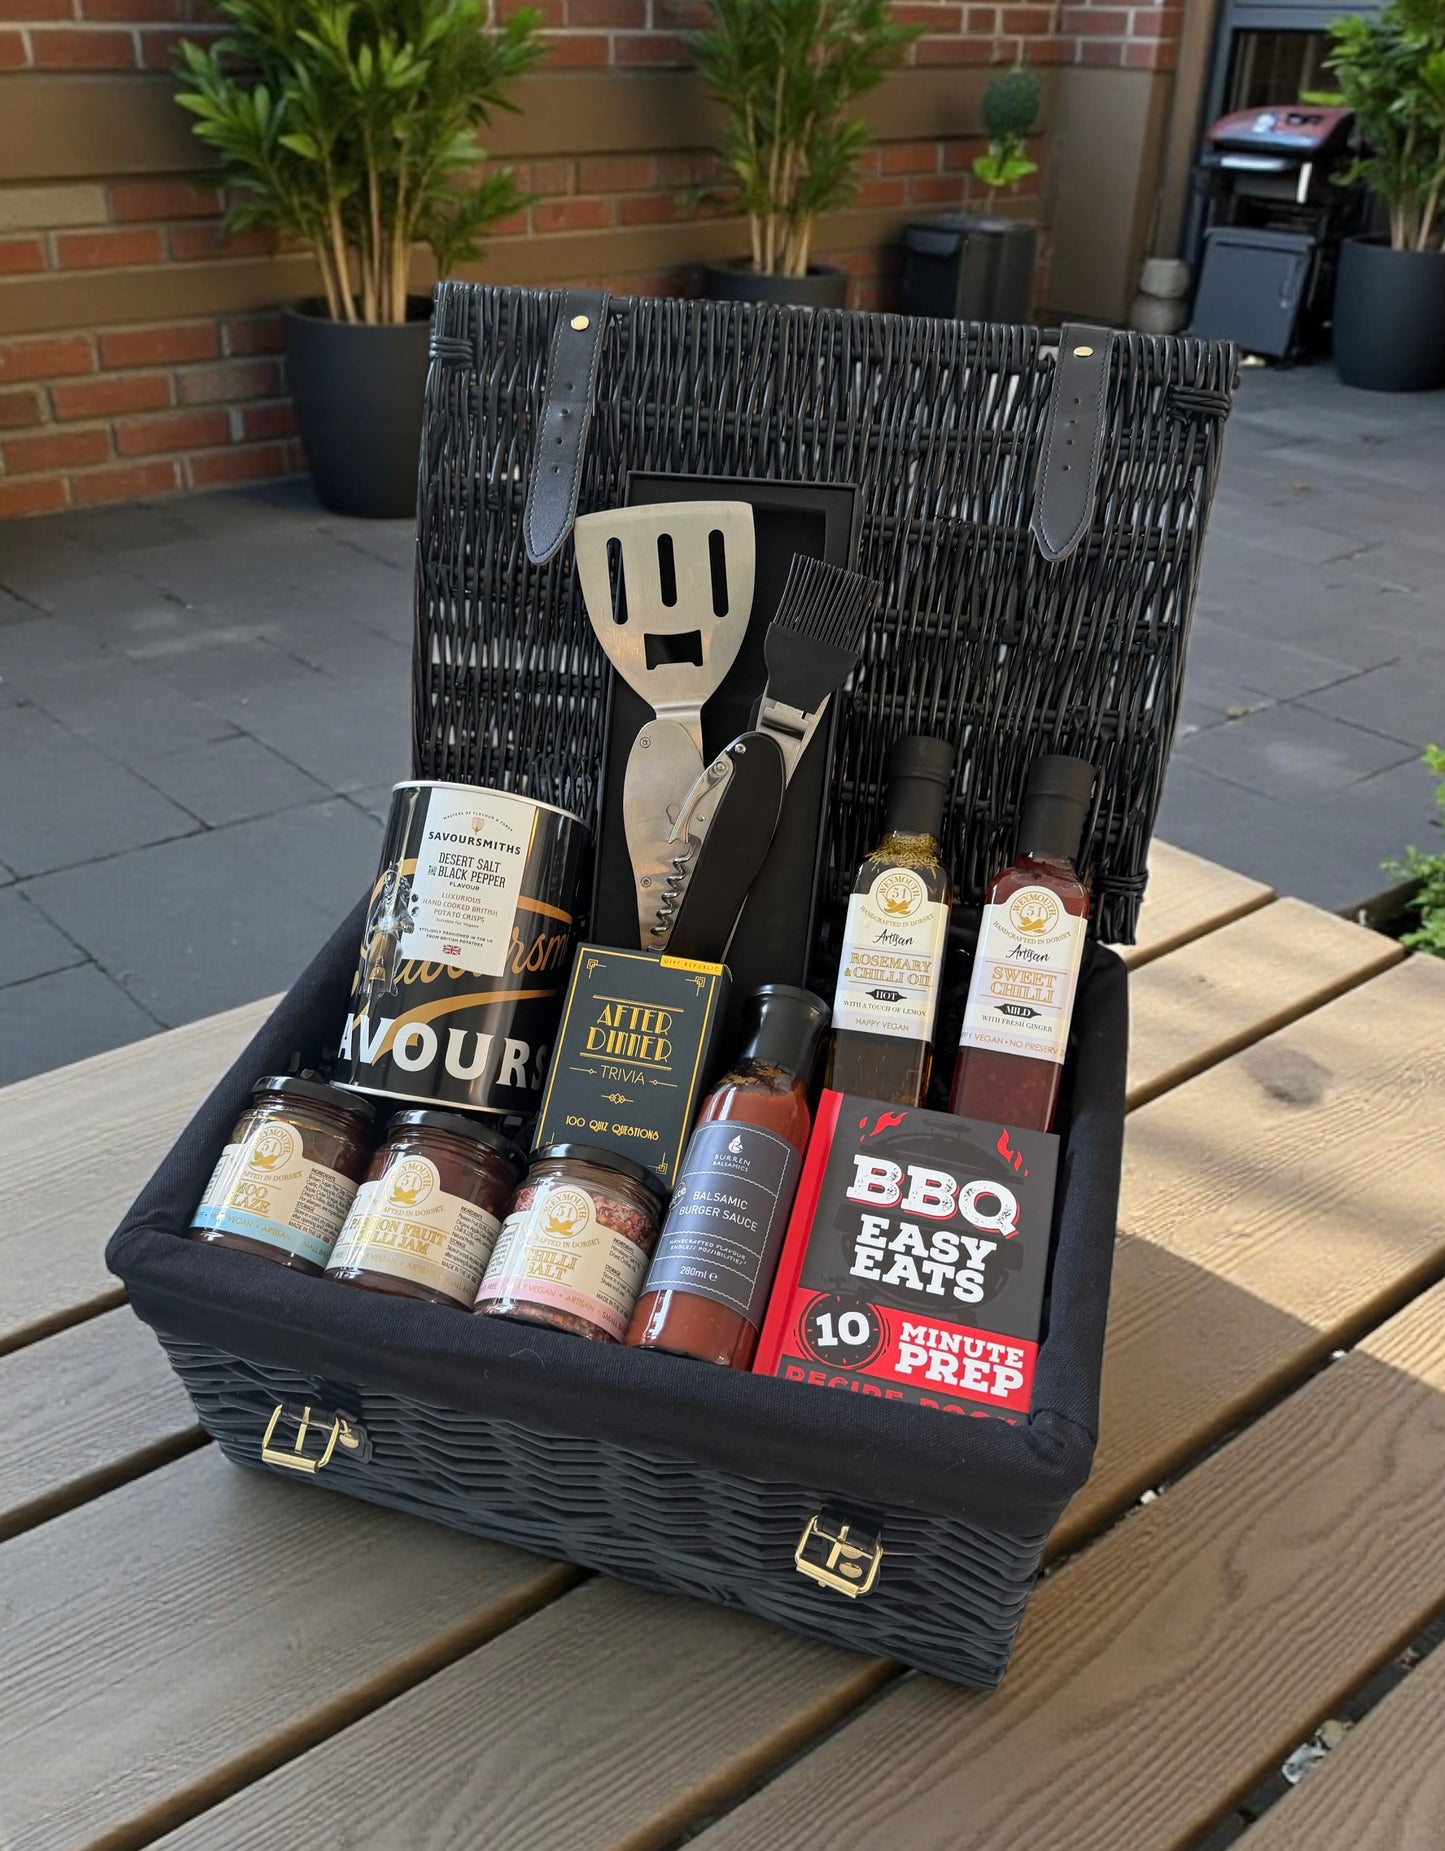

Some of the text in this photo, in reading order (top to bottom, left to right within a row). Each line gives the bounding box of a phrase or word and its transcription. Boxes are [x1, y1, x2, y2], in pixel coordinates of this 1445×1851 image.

[428, 831, 521, 855] SAVOURSMITHS
[439, 852, 501, 873] DESERT SALT
[438, 865, 469, 881] BLACK
[470, 870, 506, 888] PEPPER
[449, 881, 480, 891] FLAVOUR
[441, 892, 482, 904] LUXURIOUS
[879, 876, 920, 899] WEYMOUTH
[891, 887, 906, 900] 51
[423, 898, 498, 917] HAND COOKED BRITISH
[1012, 893, 1057, 917] WEYMOUTH
[1026, 905, 1042, 918] 51
[434, 909, 485, 923] POTATO CRISPS
[860, 905, 902, 928] HANDCRAFTED
[910, 912, 935, 927] DORSET
[873, 929, 915, 946] Artisan
[993, 920, 1036, 945] HANDCRAFTED
[1046, 931, 1072, 944] DORSET
[849, 952, 934, 974] ROSEMARY
[1005, 943, 1051, 963] Artisan
[844, 966, 933, 989] & CHILLI OIL
[992, 966, 1057, 988] SWEET
[875, 990, 898, 1001] HOT
[990, 981, 1055, 1004] CHILLI
[597, 1003, 673, 1035] AFTER
[843, 1000, 862, 1009] WITH
[868, 1002, 891, 1013] TOUCH
[903, 1008, 926, 1017] LEMON
[1005, 1005, 1031, 1017] MILD
[856, 1018, 909, 1032] HAPPY VEGAN
[982, 1015, 1053, 1033] WITH FRESH GINGER
[585, 1026, 673, 1063] DINNER
[974, 1033, 1004, 1045] VEGAN
[1009, 1038, 1023, 1048] NO
[600, 1065, 645, 1085] TRIVIA
[565, 1115, 660, 1141] 100 QUIZ QUESTIONS
[712, 1161, 749, 1173] BALSAMICS
[714, 1154, 750, 1166] BURREN
[273, 1171, 302, 1181] DORSET
[229, 1192, 271, 1214] LAZE
[693, 1191, 748, 1210] BALSAMIC
[846, 1153, 1019, 1238] BBQ
[414, 1205, 444, 1217] DORSET
[678, 1205, 758, 1232] BURGER SAUCE
[401, 1222, 447, 1247] FRUIT
[572, 1238, 600, 1249] DORSET
[856, 1213, 997, 1271] EASY
[397, 1235, 430, 1256] JAM
[716, 1244, 746, 1260] FLAVOUR
[525, 1248, 579, 1271] CHILLI
[527, 1260, 566, 1280] SALT
[680, 1265, 707, 1279] 280ml
[849, 1245, 985, 1304] EATS
[528, 1285, 557, 1297] VEGAN
[565, 1295, 596, 1312] ARTISAN
[816, 1311, 871, 1346] 10
[900, 1322, 1025, 1369] MINUTE
[894, 1341, 1025, 1398] PREP
